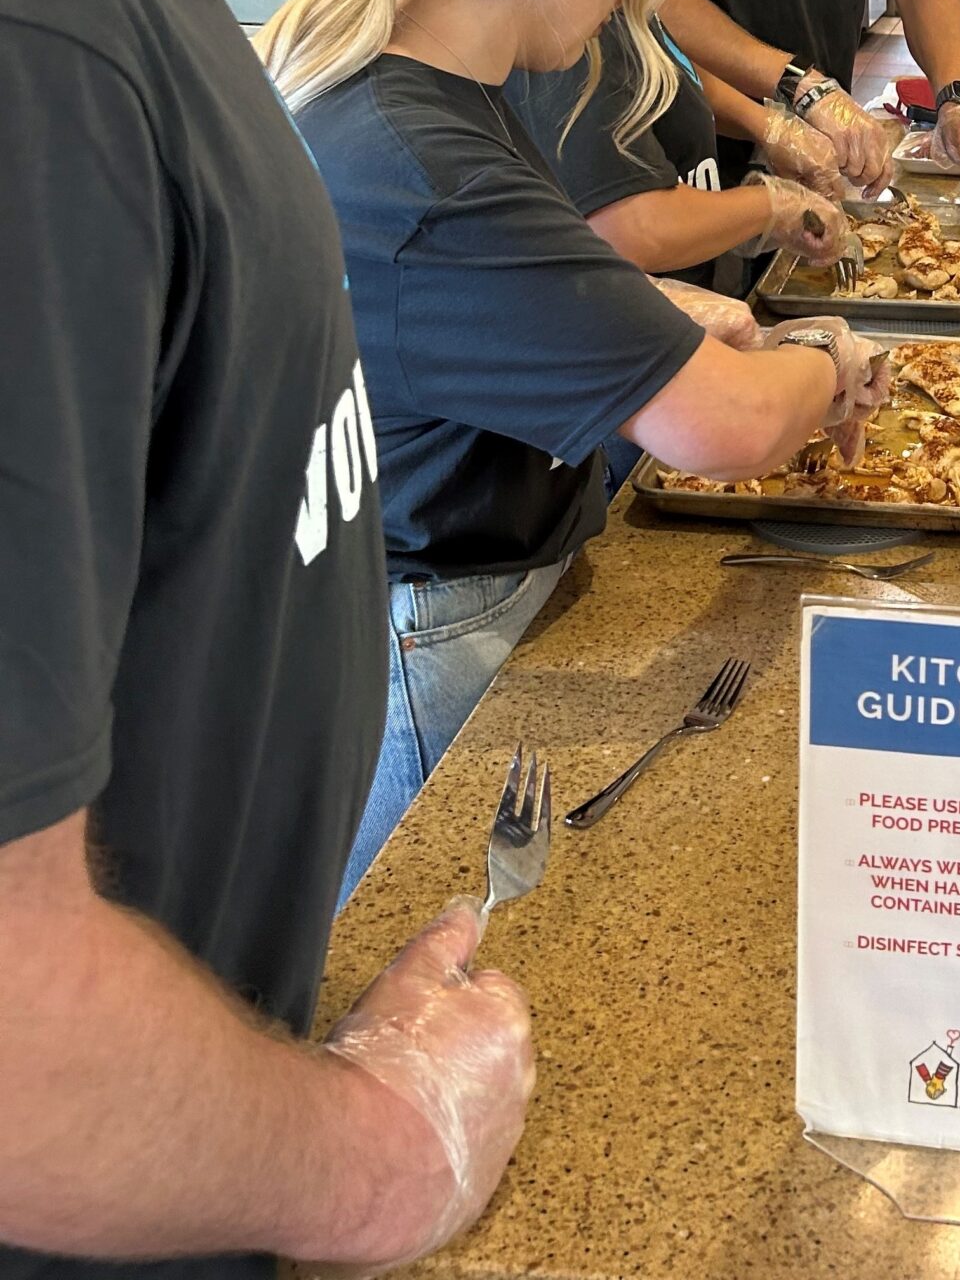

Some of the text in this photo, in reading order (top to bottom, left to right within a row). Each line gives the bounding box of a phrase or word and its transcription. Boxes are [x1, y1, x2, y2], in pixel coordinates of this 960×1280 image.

[859, 793, 928, 812] PLEASE
[872, 814, 922, 831] FOOD
[858, 854, 932, 873] ALWAYS
[871, 875, 929, 893] WHEN
[857, 935, 952, 956] DISINFECT
